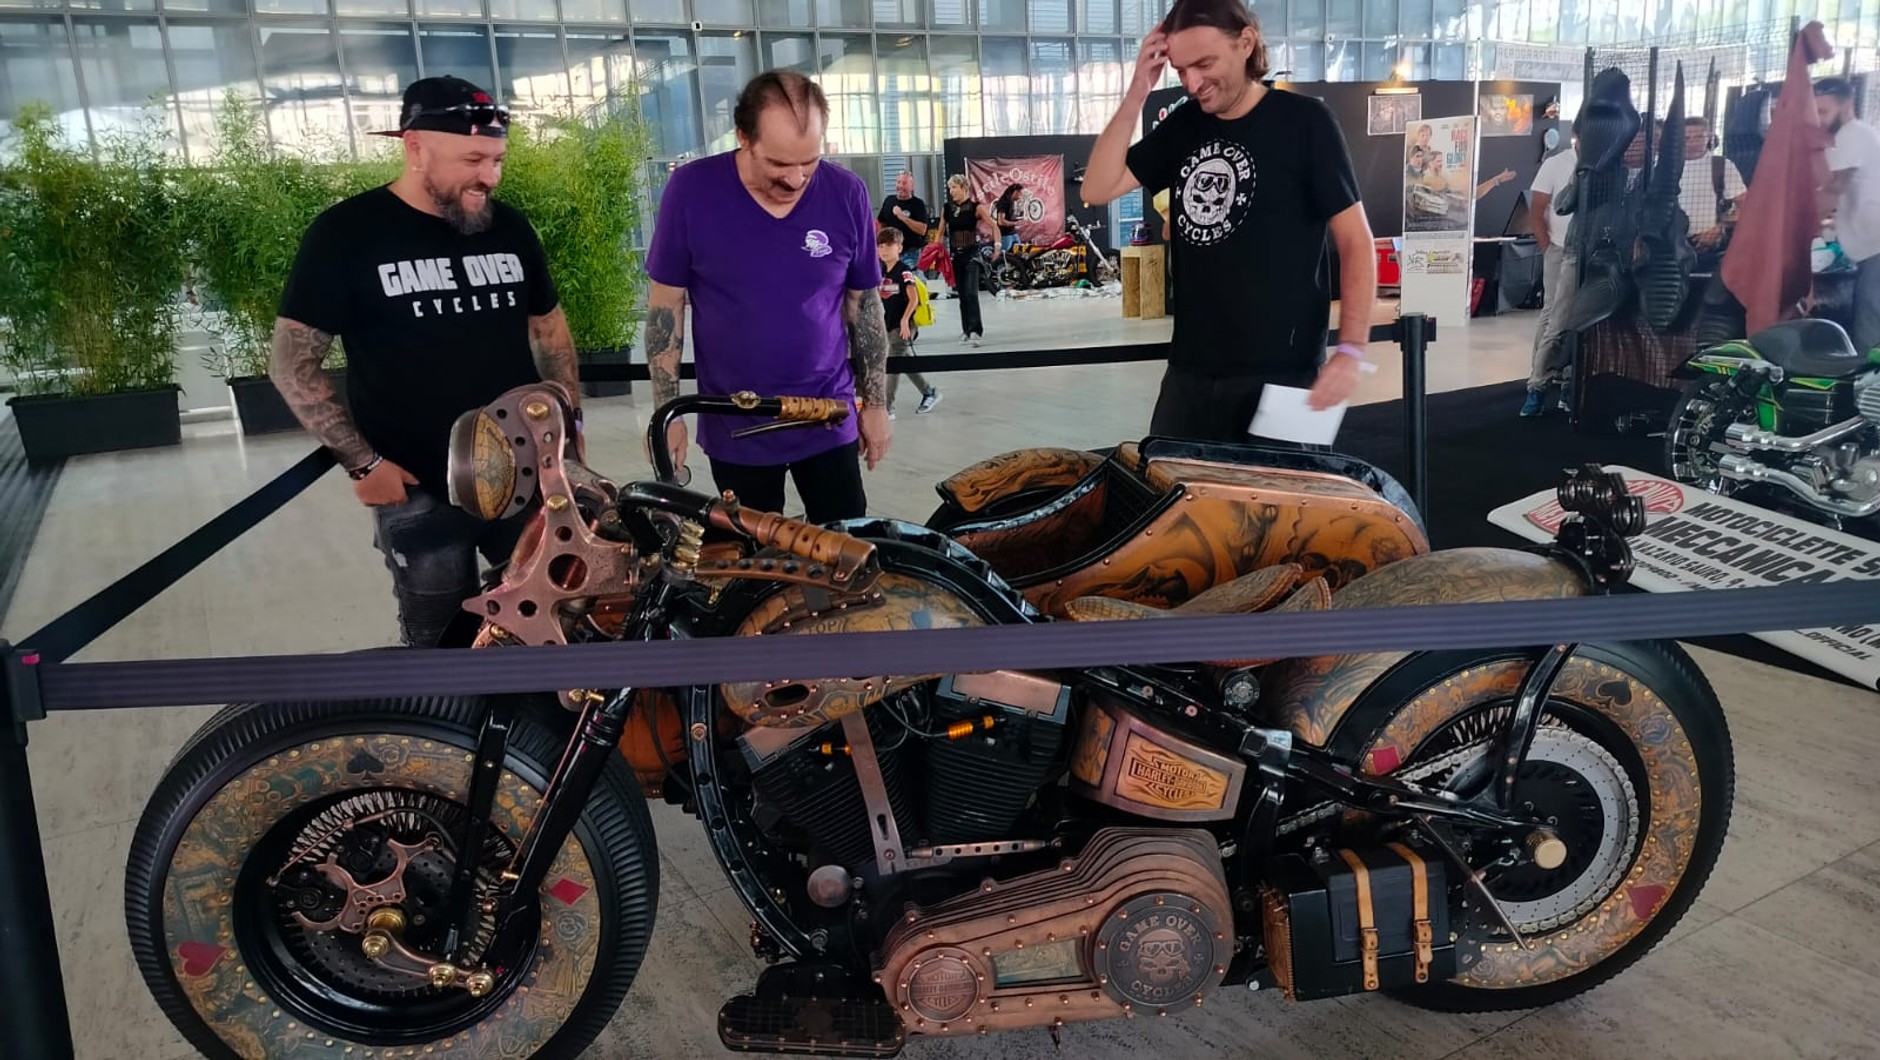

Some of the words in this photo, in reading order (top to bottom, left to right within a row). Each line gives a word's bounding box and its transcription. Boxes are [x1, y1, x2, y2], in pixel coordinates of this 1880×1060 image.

[1180, 142, 1220, 178] GAME
[1223, 146, 1251, 182] OVER
[1178, 214, 1232, 241] CYCLES
[378, 257, 458, 297] GAME
[462, 252, 524, 287] OVER
[412, 291, 516, 317] CYCLES
[1683, 502, 1869, 566] MOTOCICLETTE
[1120, 915, 1160, 951] GAME
[1165, 915, 1201, 945] OVER
